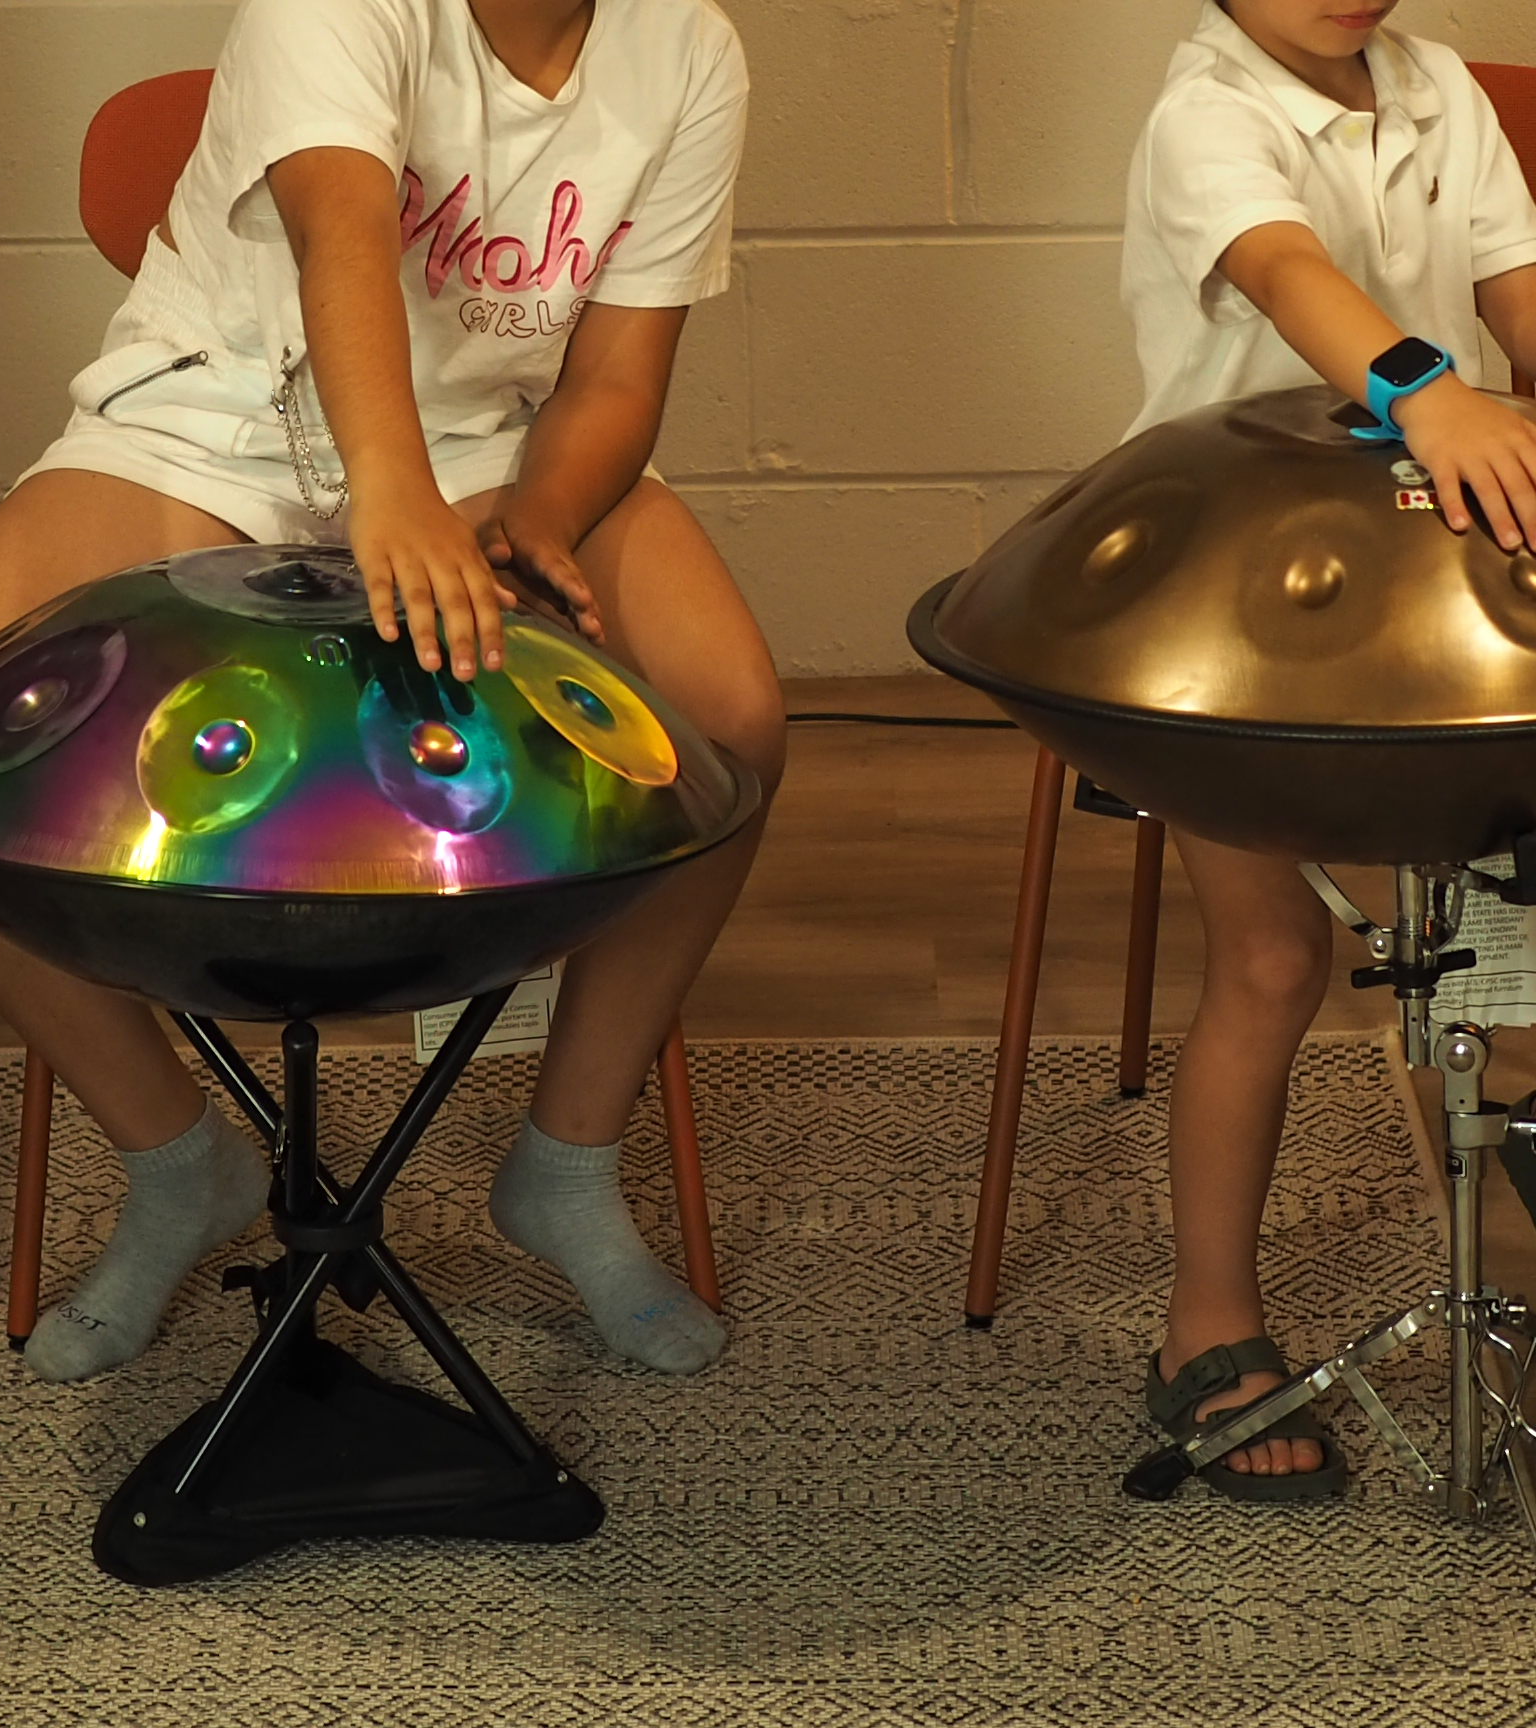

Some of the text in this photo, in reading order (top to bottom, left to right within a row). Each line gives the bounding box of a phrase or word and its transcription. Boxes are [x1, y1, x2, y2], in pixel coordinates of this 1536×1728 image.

[1472, 908, 1491, 918] STATE
[1492, 907, 1508, 916] HAS
[1484, 916, 1524, 925] RETARDANT
[1466, 927, 1489, 936] BEING
[1490, 925, 1517, 934] KNOWN
[1479, 934, 1518, 944] SUSPECTED
[1496, 942, 1523, 951] HUMAN
[423, 1012, 458, 1021] Consumer
